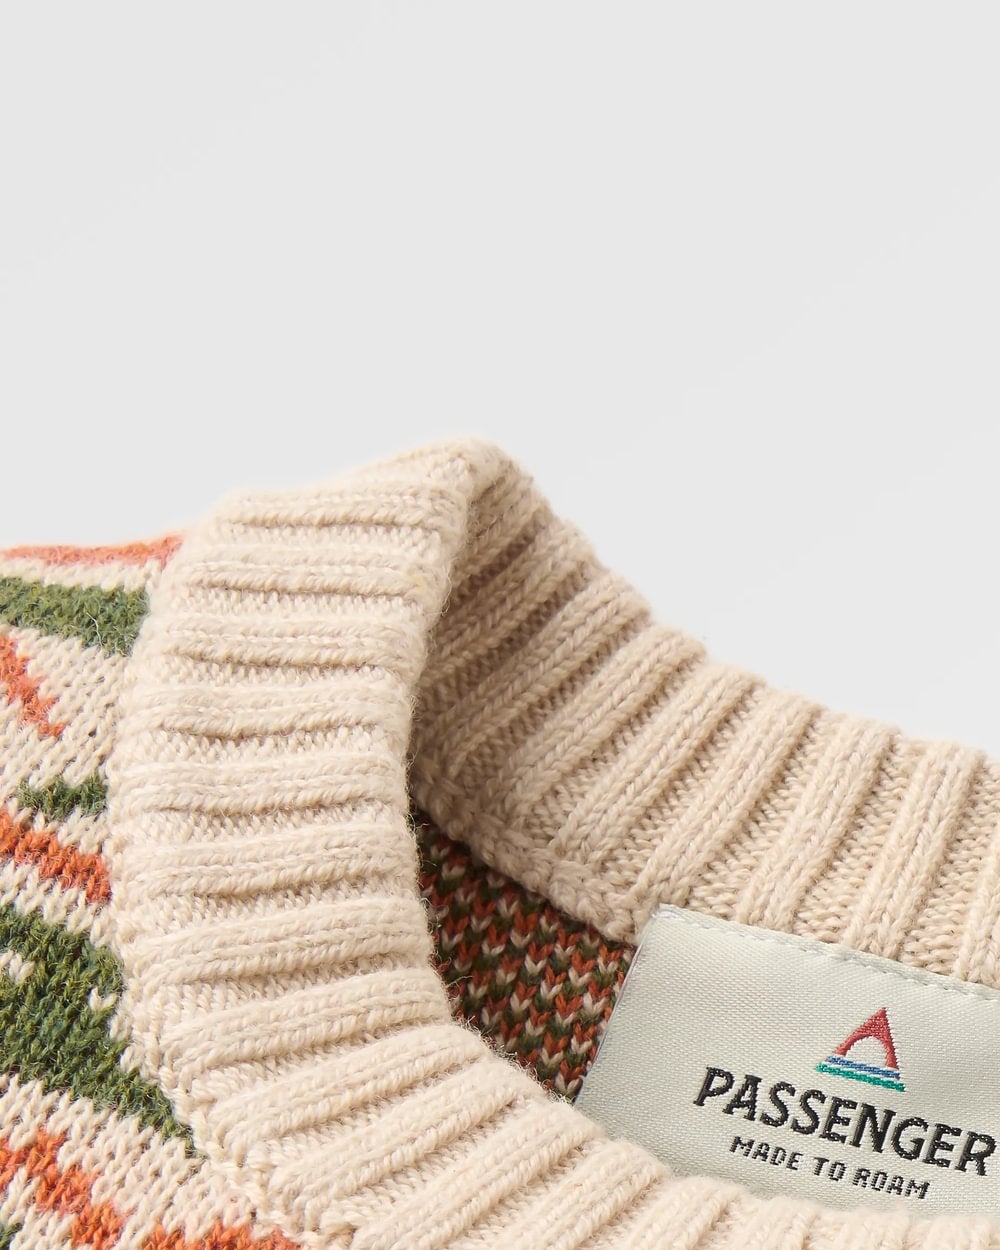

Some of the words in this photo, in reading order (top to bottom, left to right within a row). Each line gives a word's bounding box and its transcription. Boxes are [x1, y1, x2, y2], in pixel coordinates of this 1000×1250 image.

[693, 1066, 997, 1177] PASSENGER
[729, 1136, 804, 1171] MADE
[813, 1156, 847, 1182] TO
[854, 1167, 931, 1200] ROAM
